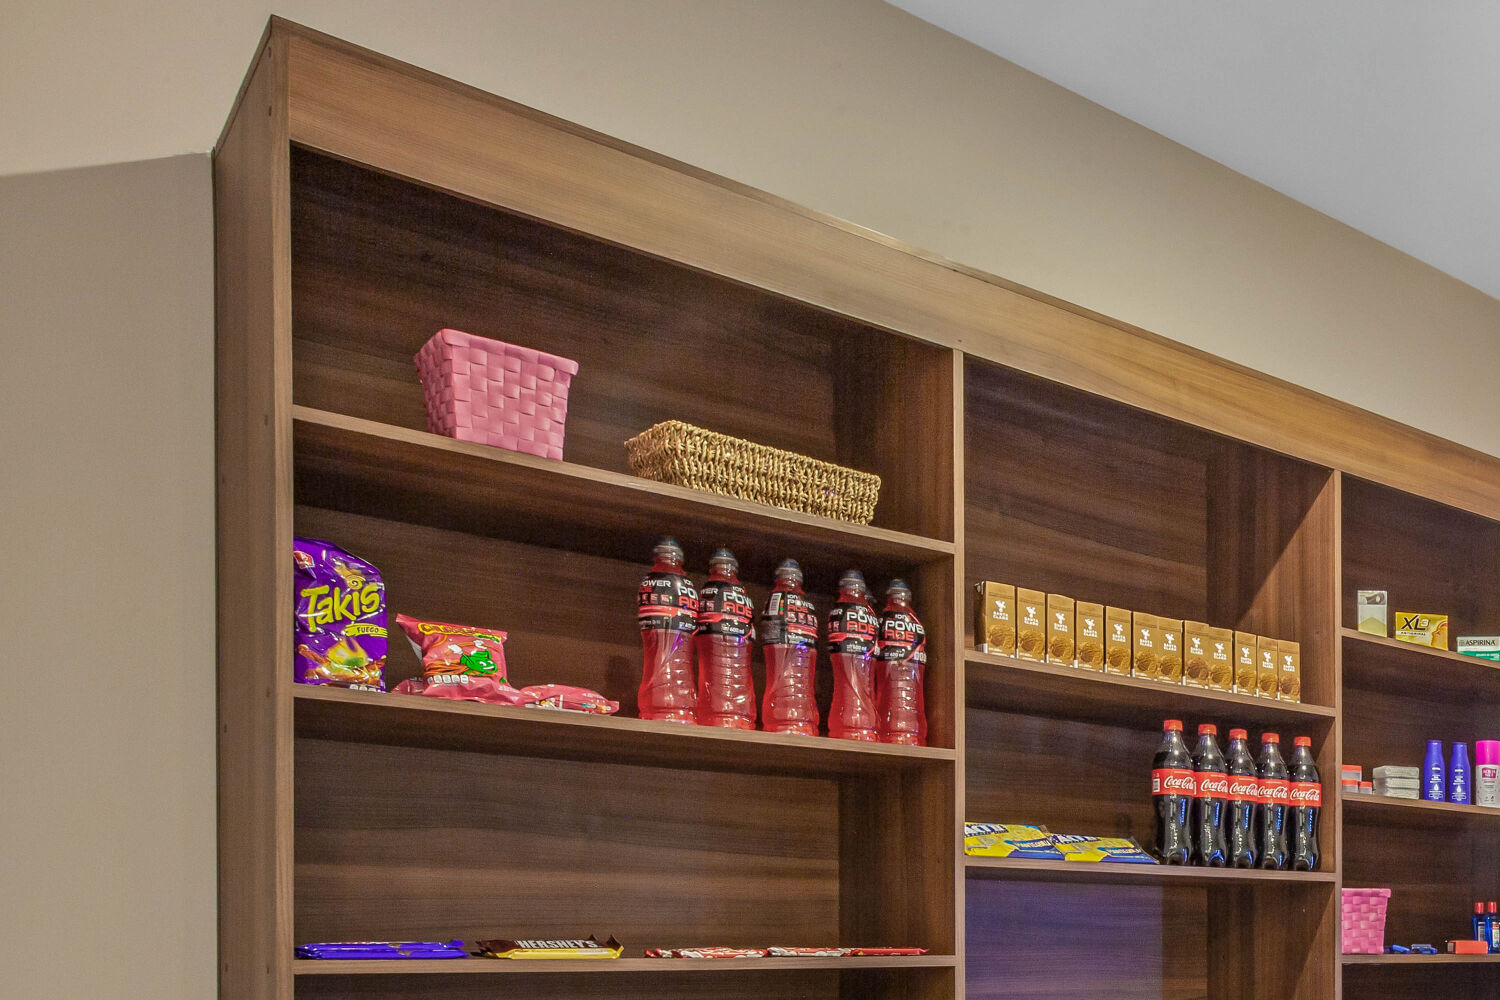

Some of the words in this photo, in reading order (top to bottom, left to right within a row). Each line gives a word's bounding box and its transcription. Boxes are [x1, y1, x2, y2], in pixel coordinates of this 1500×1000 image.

[301, 584, 381, 632] Takis
[885, 631, 915, 642] ADE
[517, 939, 599, 949] HERSHEY'S
